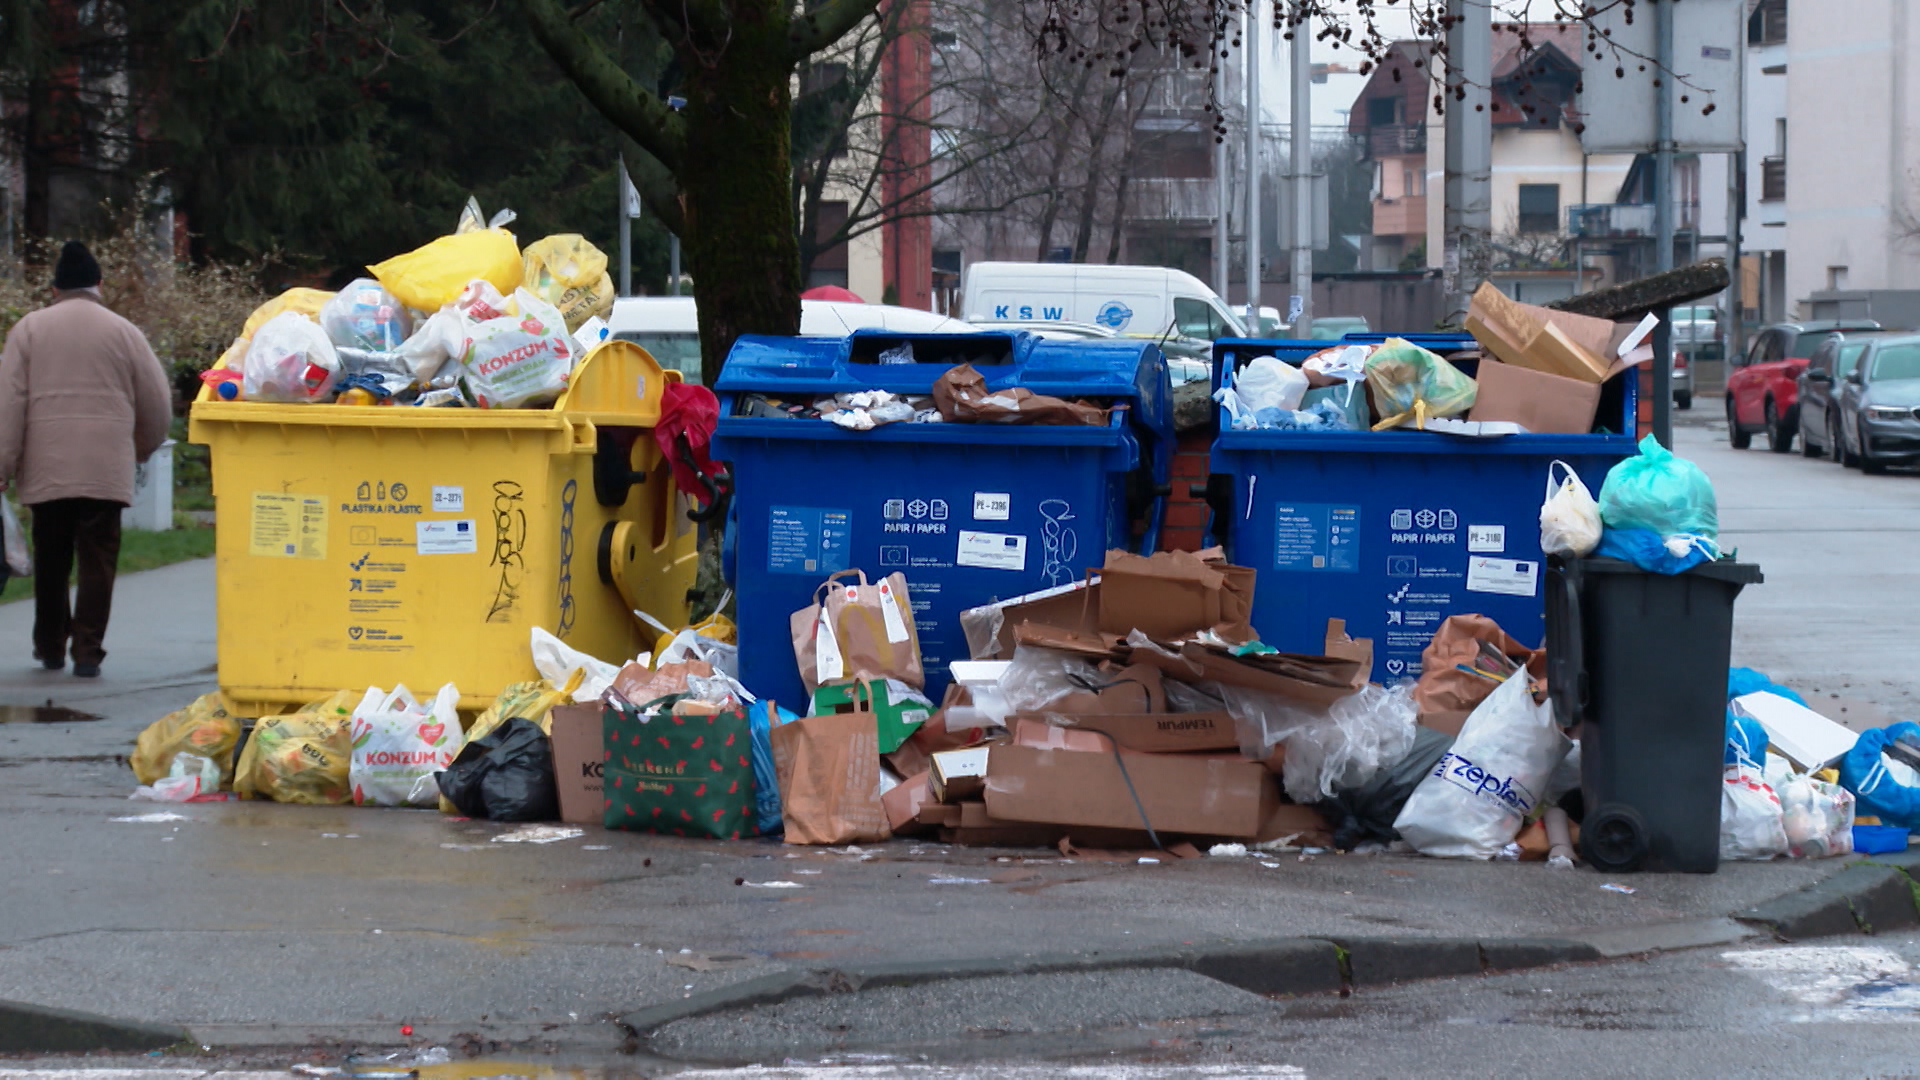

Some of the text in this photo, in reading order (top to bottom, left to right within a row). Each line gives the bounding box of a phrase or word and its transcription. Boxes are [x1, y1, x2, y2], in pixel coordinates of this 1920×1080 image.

[479, 340, 548, 375] KONZUM
[342, 504, 382, 513] PLASTIKA
[388, 505, 422, 514] PLASTIC
[884, 523, 910, 533] PAPIR
[916, 523, 946, 534] PAPER
[1391, 533, 1418, 543] PAPIR
[1425, 533, 1455, 544] PAPER
[1157, 719, 1215, 730] TEMPUR
[365, 751, 436, 765] KONZUM
